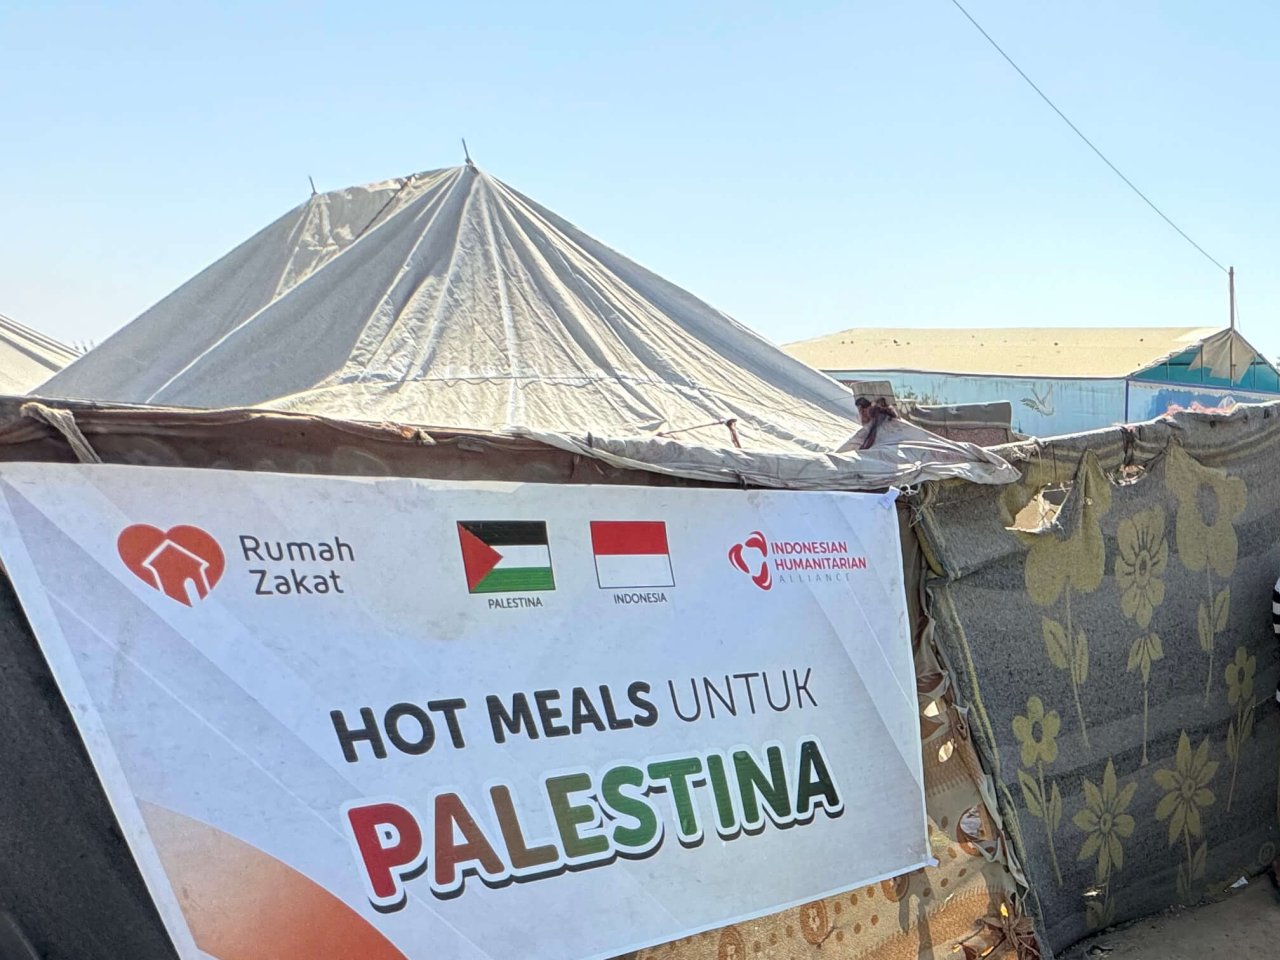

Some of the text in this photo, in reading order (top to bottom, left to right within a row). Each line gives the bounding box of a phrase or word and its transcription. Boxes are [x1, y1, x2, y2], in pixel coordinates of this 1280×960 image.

[239, 535, 355, 562] Rumah
[770, 541, 848, 555] INDONESIAN
[774, 557, 867, 571] HUMANITARIAN
[248, 568, 345, 596] Zakat
[779, 573, 851, 583] ALLIANCE
[488, 597, 543, 609] PALESTINA
[613, 592, 668, 604] INDONESIA
[330, 668, 818, 764] HOT MEALS UNTUK
[345, 741, 843, 904] PALESTINA
